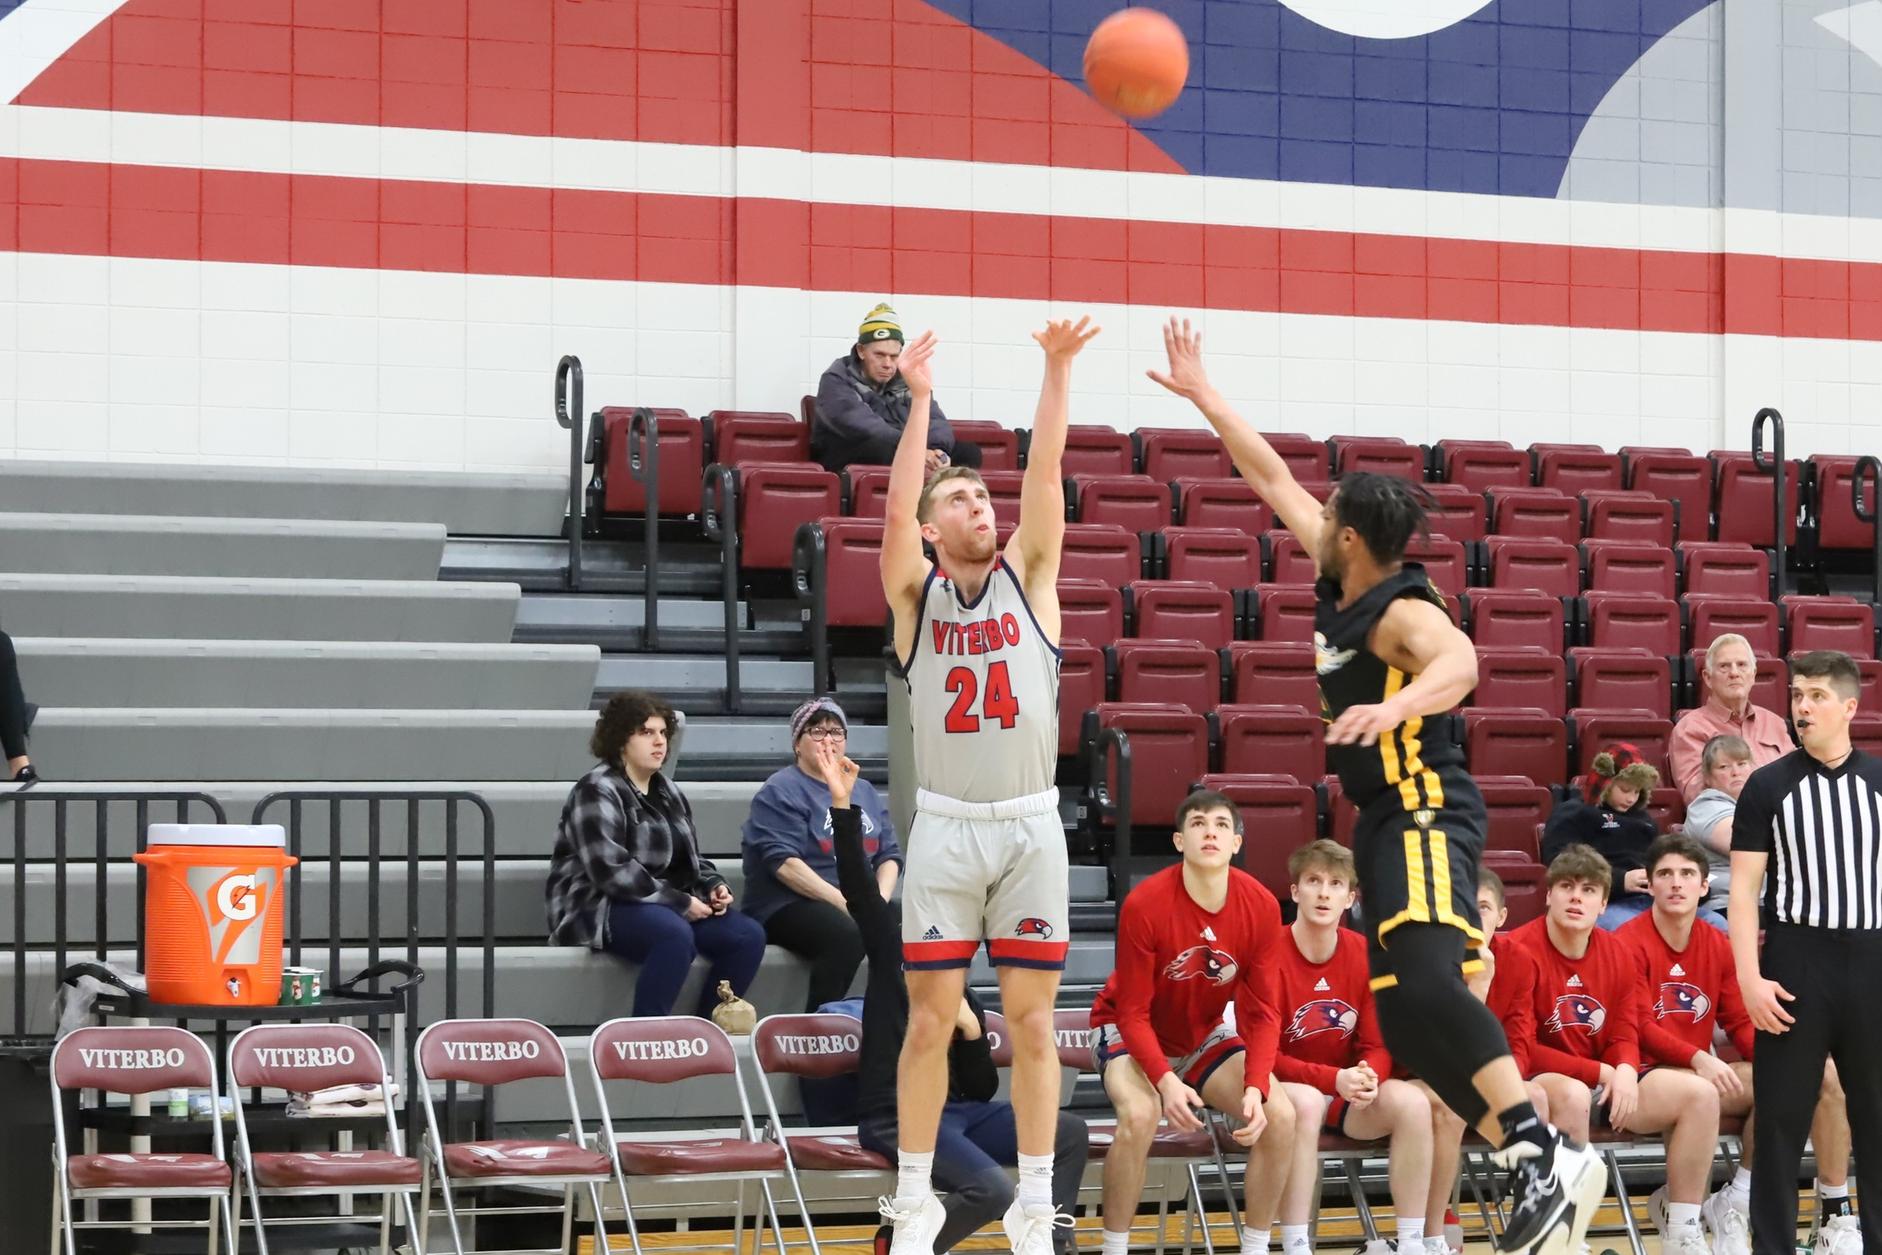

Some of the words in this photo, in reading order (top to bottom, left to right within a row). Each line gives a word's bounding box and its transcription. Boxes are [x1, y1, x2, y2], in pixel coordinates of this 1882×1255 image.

[873, 329, 890, 339] G
[944, 660, 1020, 733] 24
[217, 874, 256, 921] G
[442, 1040, 540, 1061] VITERBO
[612, 1037, 709, 1060] VITERBO
[774, 1034, 860, 1055] VITERBO
[78, 1047, 185, 1069] VITERBO
[253, 1045, 355, 1068] VITERBO
